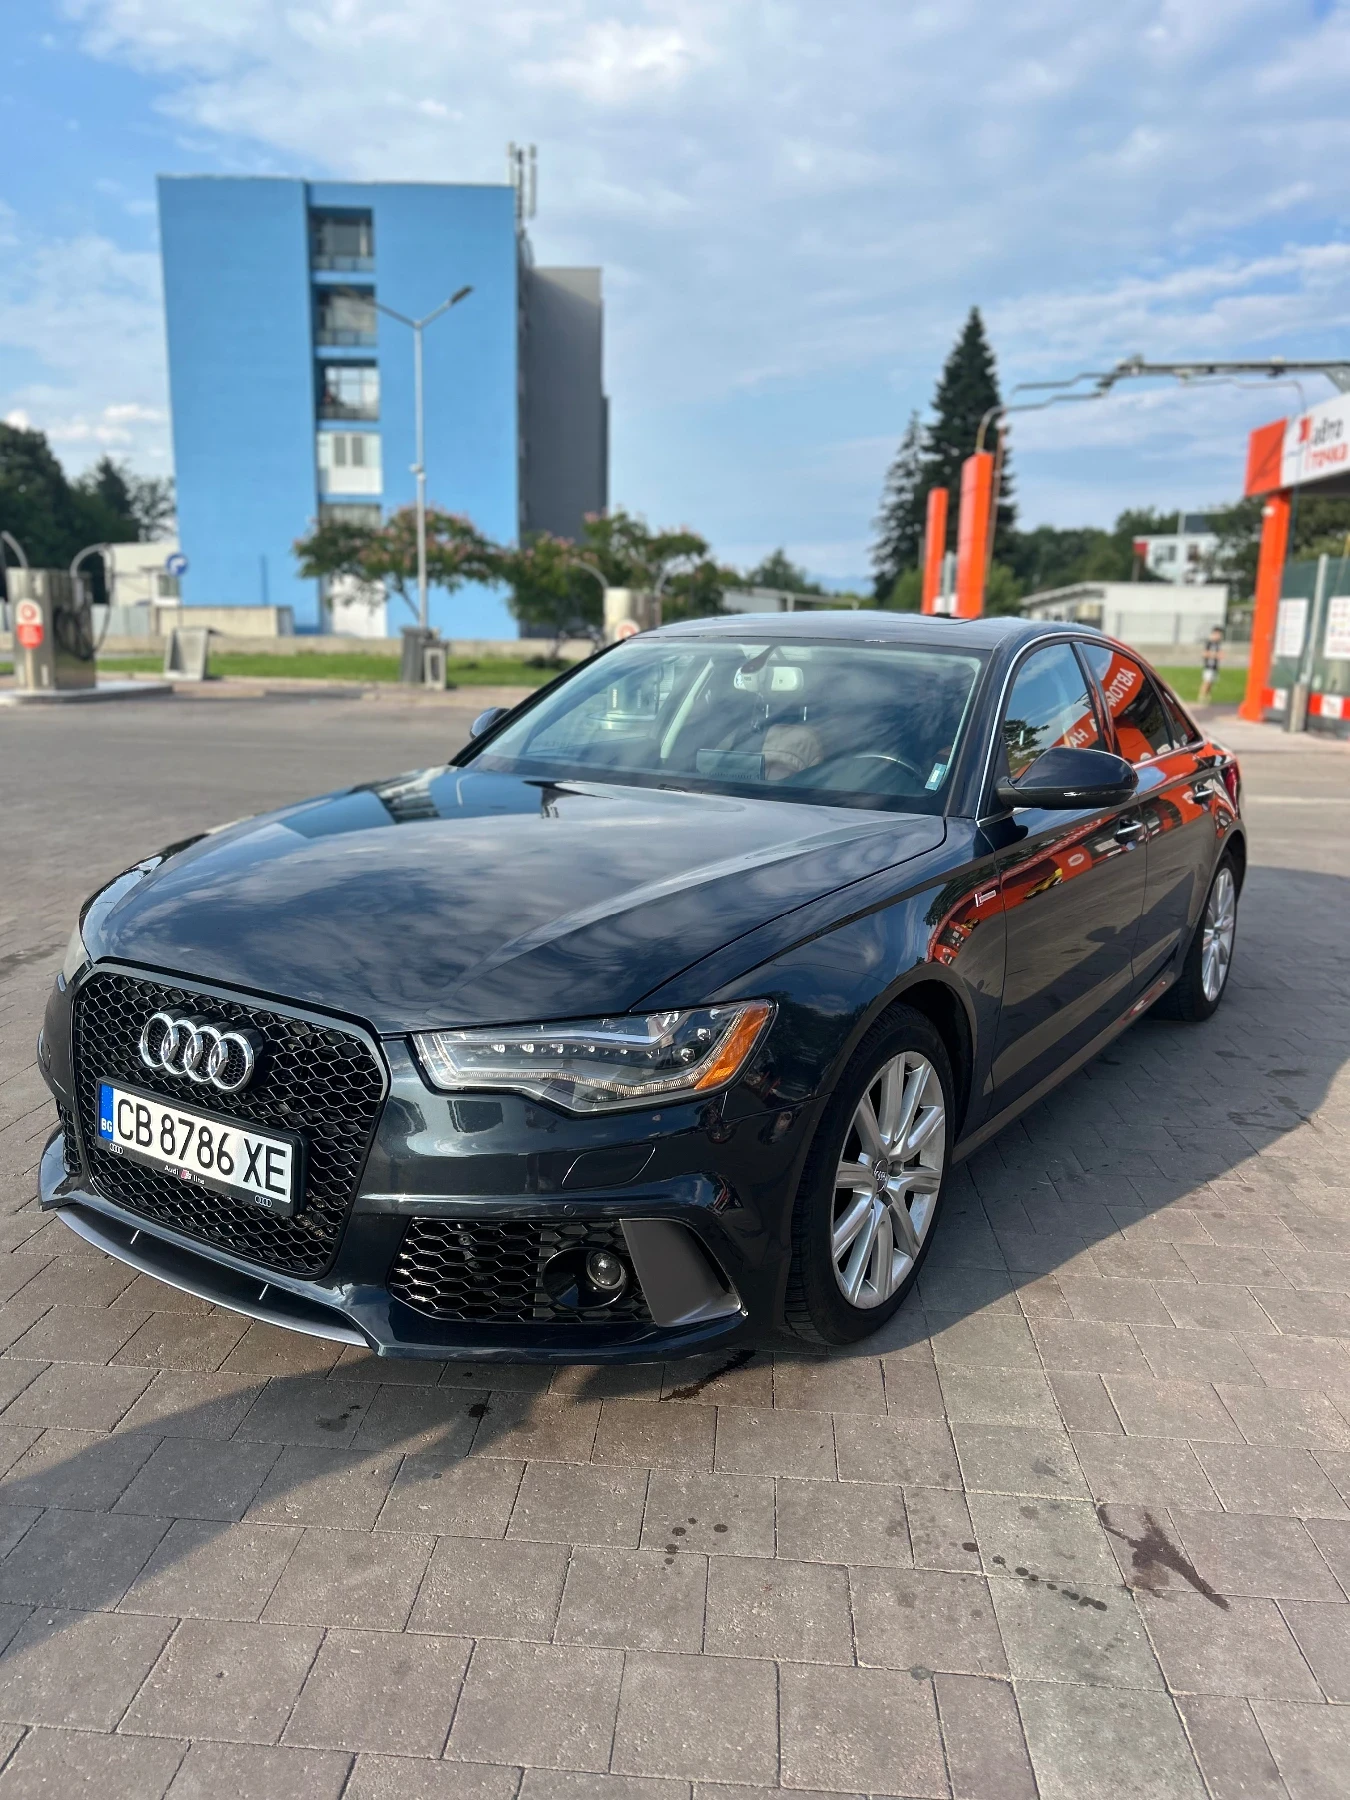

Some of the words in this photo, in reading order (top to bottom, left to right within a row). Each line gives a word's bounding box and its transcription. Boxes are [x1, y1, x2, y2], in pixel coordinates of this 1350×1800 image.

[101, 1117, 113, 1133] BG
[117, 1098, 153, 1148] CB
[160, 1113, 235, 1176] 8786
[242, 1137, 288, 1196] XE
[164, 1165, 179, 1176] Audi
